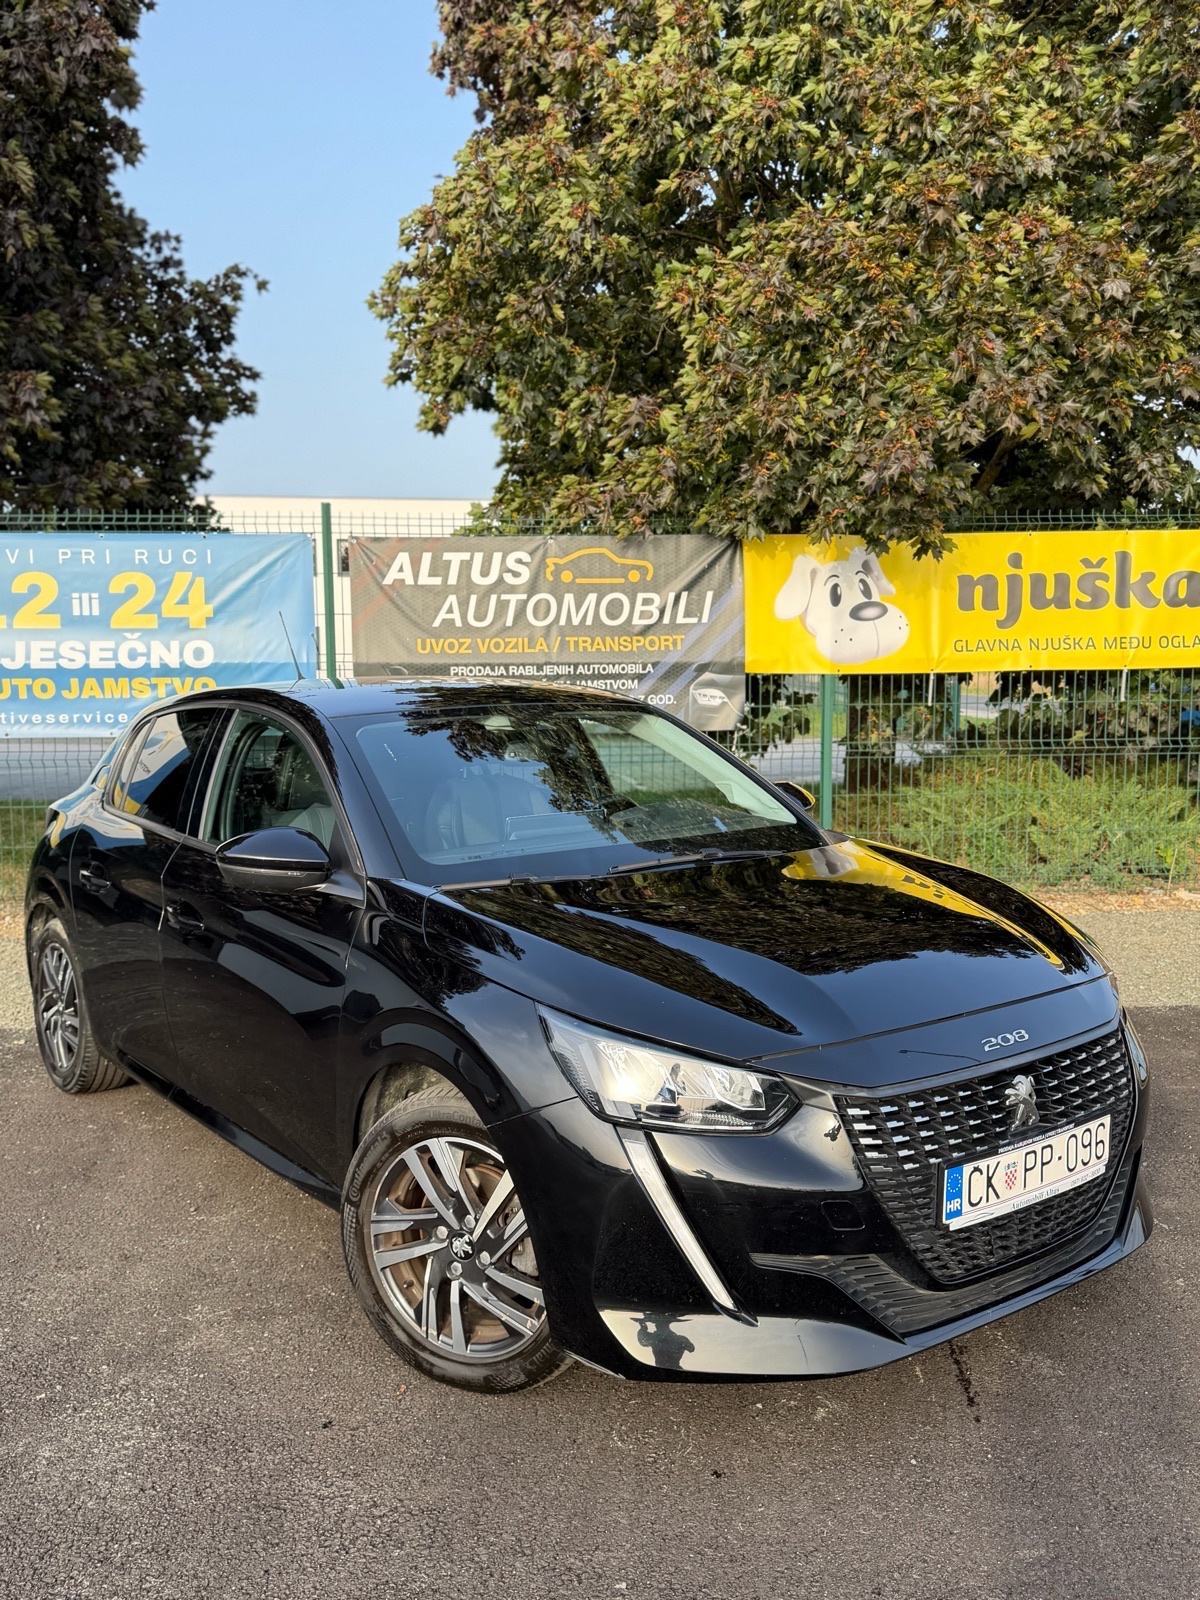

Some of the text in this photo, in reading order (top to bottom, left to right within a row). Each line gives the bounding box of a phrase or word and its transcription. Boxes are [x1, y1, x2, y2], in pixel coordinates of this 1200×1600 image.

[5, 549, 212, 564] VI PRI RUCI
[382, 550, 532, 586] ALTUS
[0, 571, 214, 629] 2 ili 24
[431, 590, 714, 628] AUTOMOBILI
[1, 632, 215, 670] JESEČNO
[416, 635, 685, 655] UVOZ VOZILA / TRANSPORT
[953, 632, 1200, 653] GLAVNA NJUŠKA MEĐU OGLA
[450, 663, 654, 677] PRODAJA RABLJENIH AUTOMOBILA
[647, 695, 677, 705] GOD.
[981, 1029, 1029, 1051] 208
[967, 1161, 1000, 1208] ČK
[946, 1199, 961, 1214] HR
